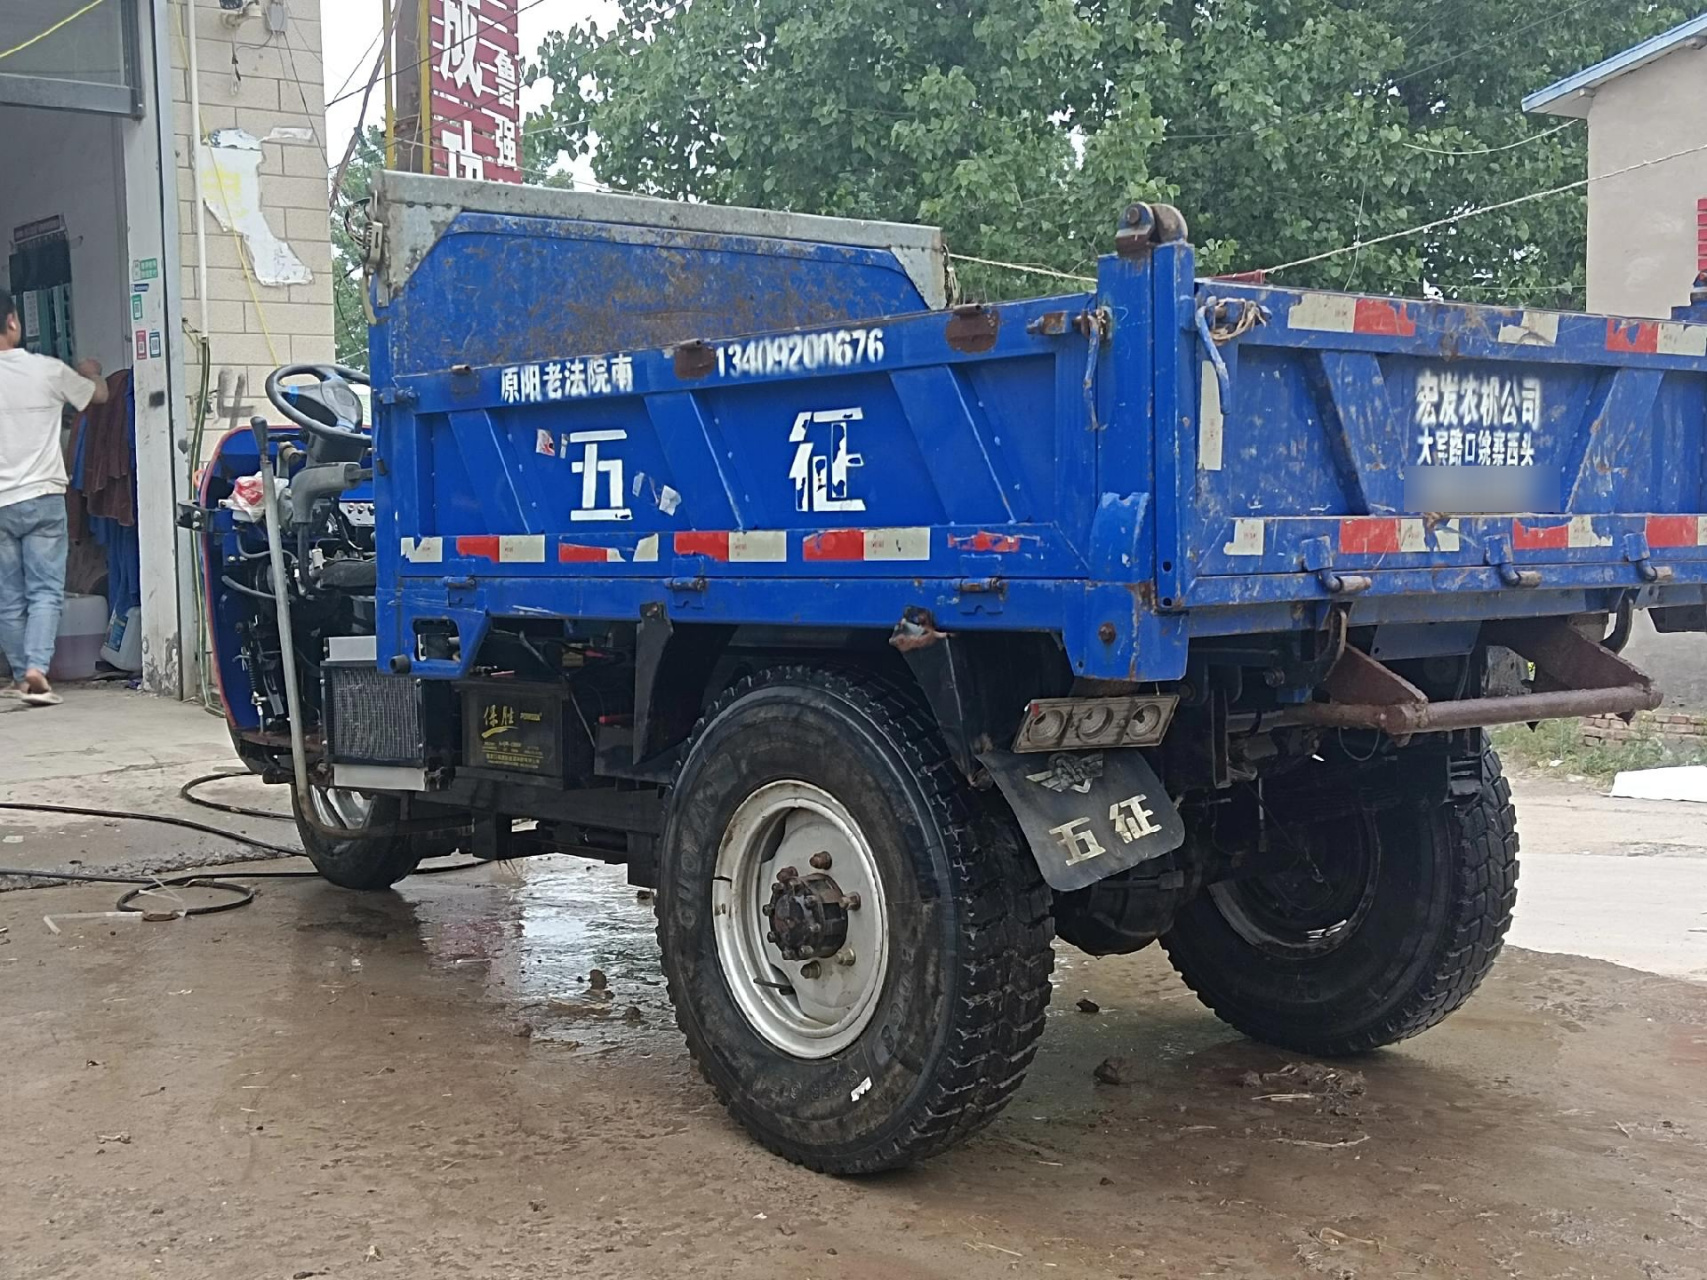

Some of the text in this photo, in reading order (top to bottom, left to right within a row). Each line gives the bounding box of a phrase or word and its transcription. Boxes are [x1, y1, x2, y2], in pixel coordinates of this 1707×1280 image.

[494, 52, 519, 184] 鲁强
[501, 328, 885, 404] 原阳老法院南 13409200676
[1415, 368, 1542, 431] 宏发农机公司
[1048, 793, 1163, 867] 五征
